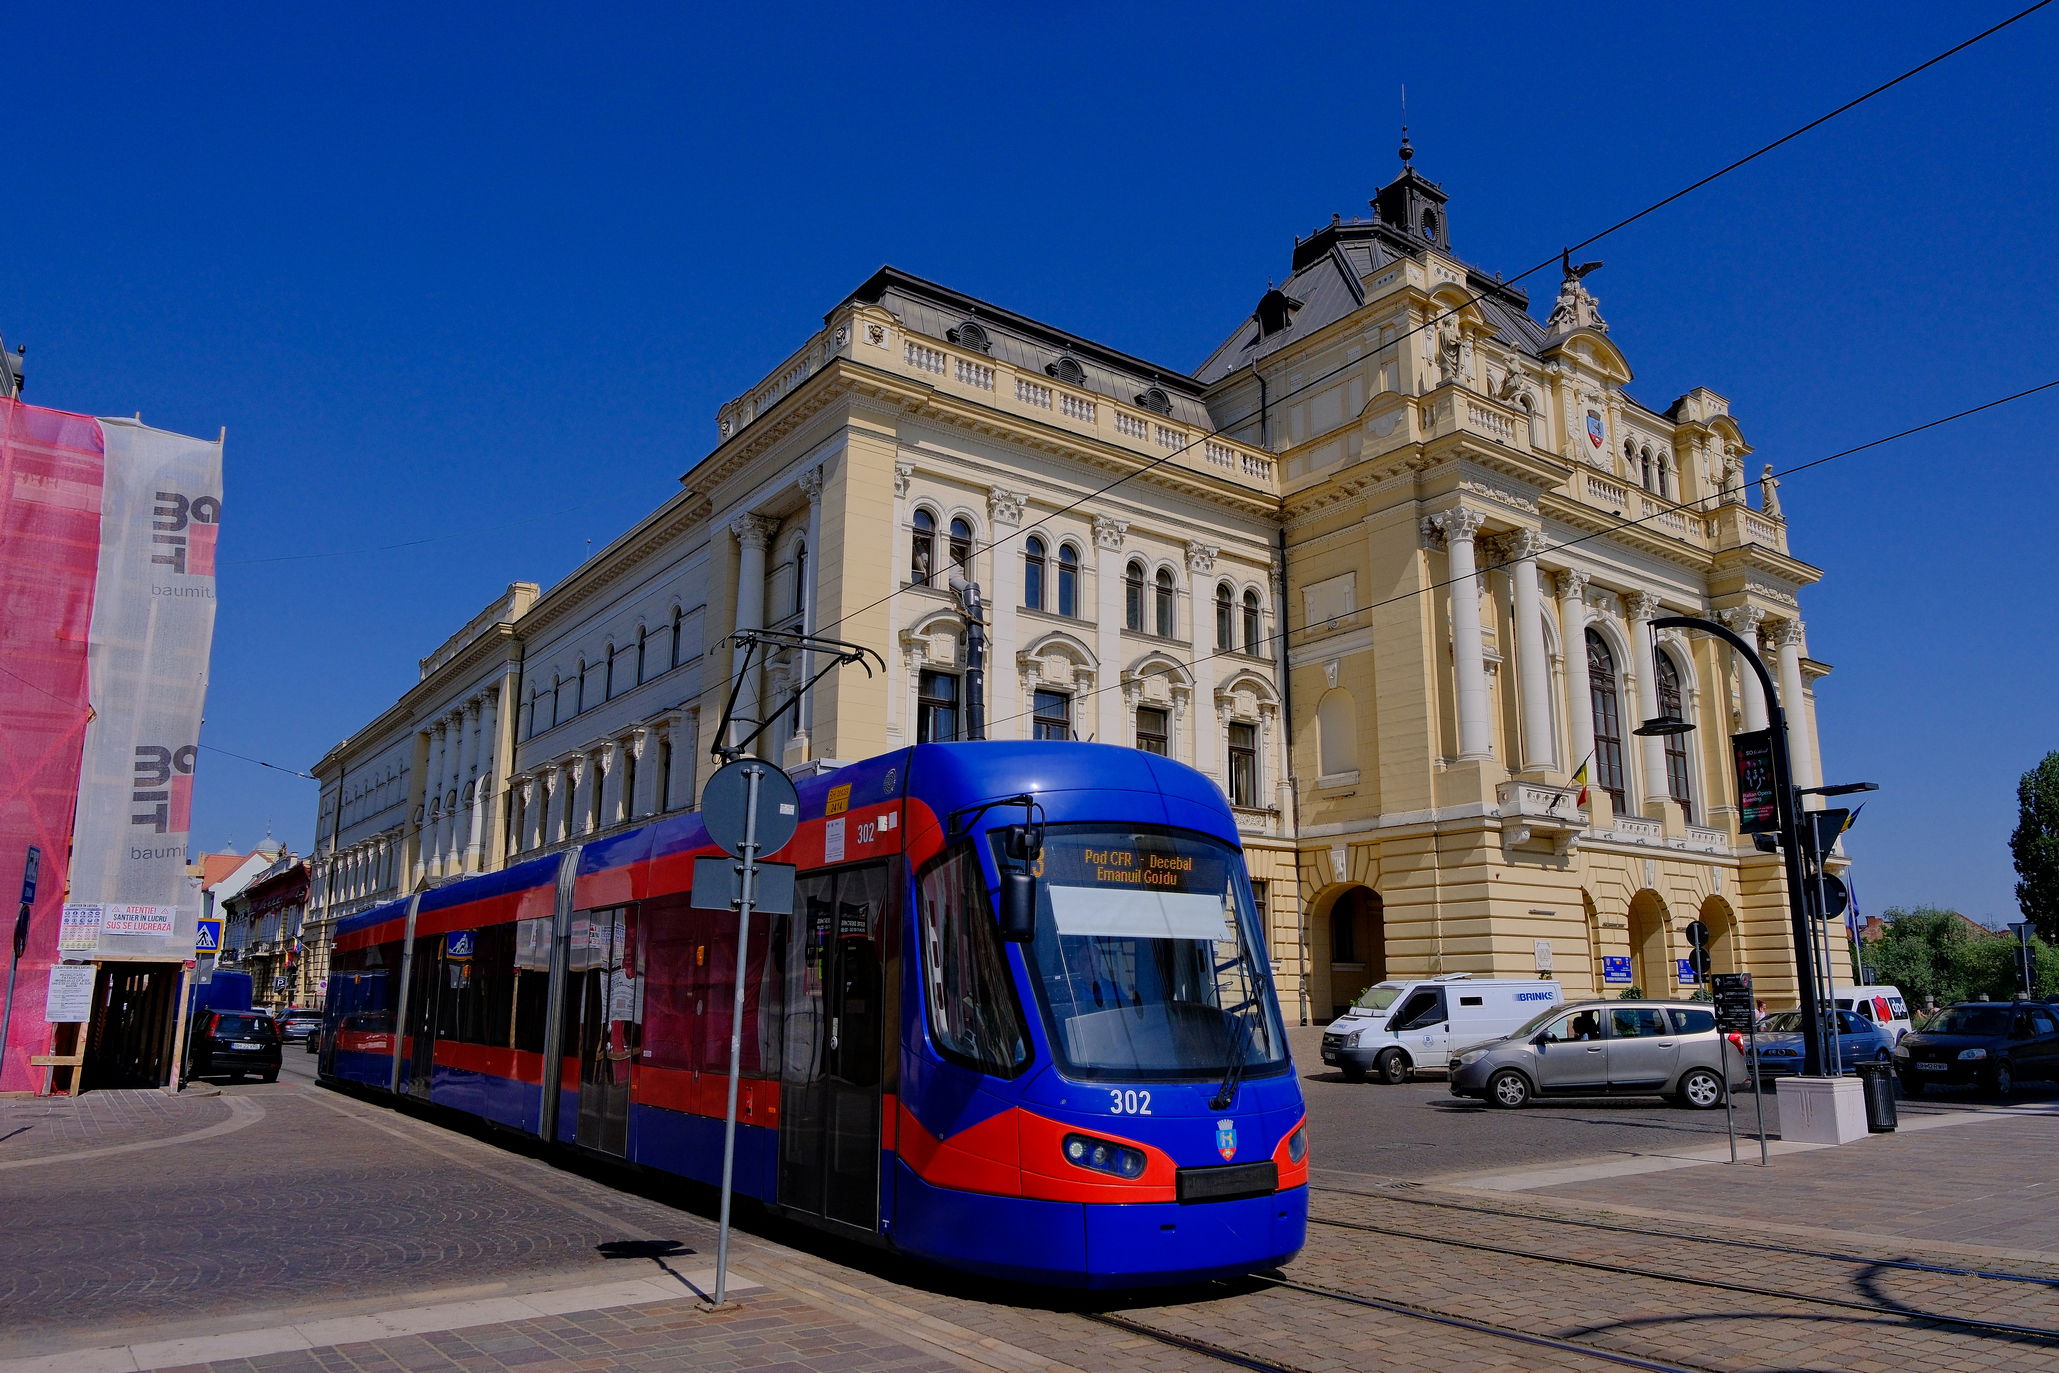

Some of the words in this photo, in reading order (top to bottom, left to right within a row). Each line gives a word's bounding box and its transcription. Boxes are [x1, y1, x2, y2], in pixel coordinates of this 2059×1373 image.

[857, 822, 875, 845] 302
[1085, 849, 1107, 865] Pod
[1110, 851, 1132, 866] CFR
[1150, 854, 1193, 871] Decebal
[1097, 866, 1141, 883] Emanuil
[106, 922, 121, 930] SUS
[122, 922, 132, 930] SE
[147, 914, 168, 923] LUCRU
[1519, 991, 1554, 1002] BRINKS
[1110, 1089, 1152, 1115] 302
